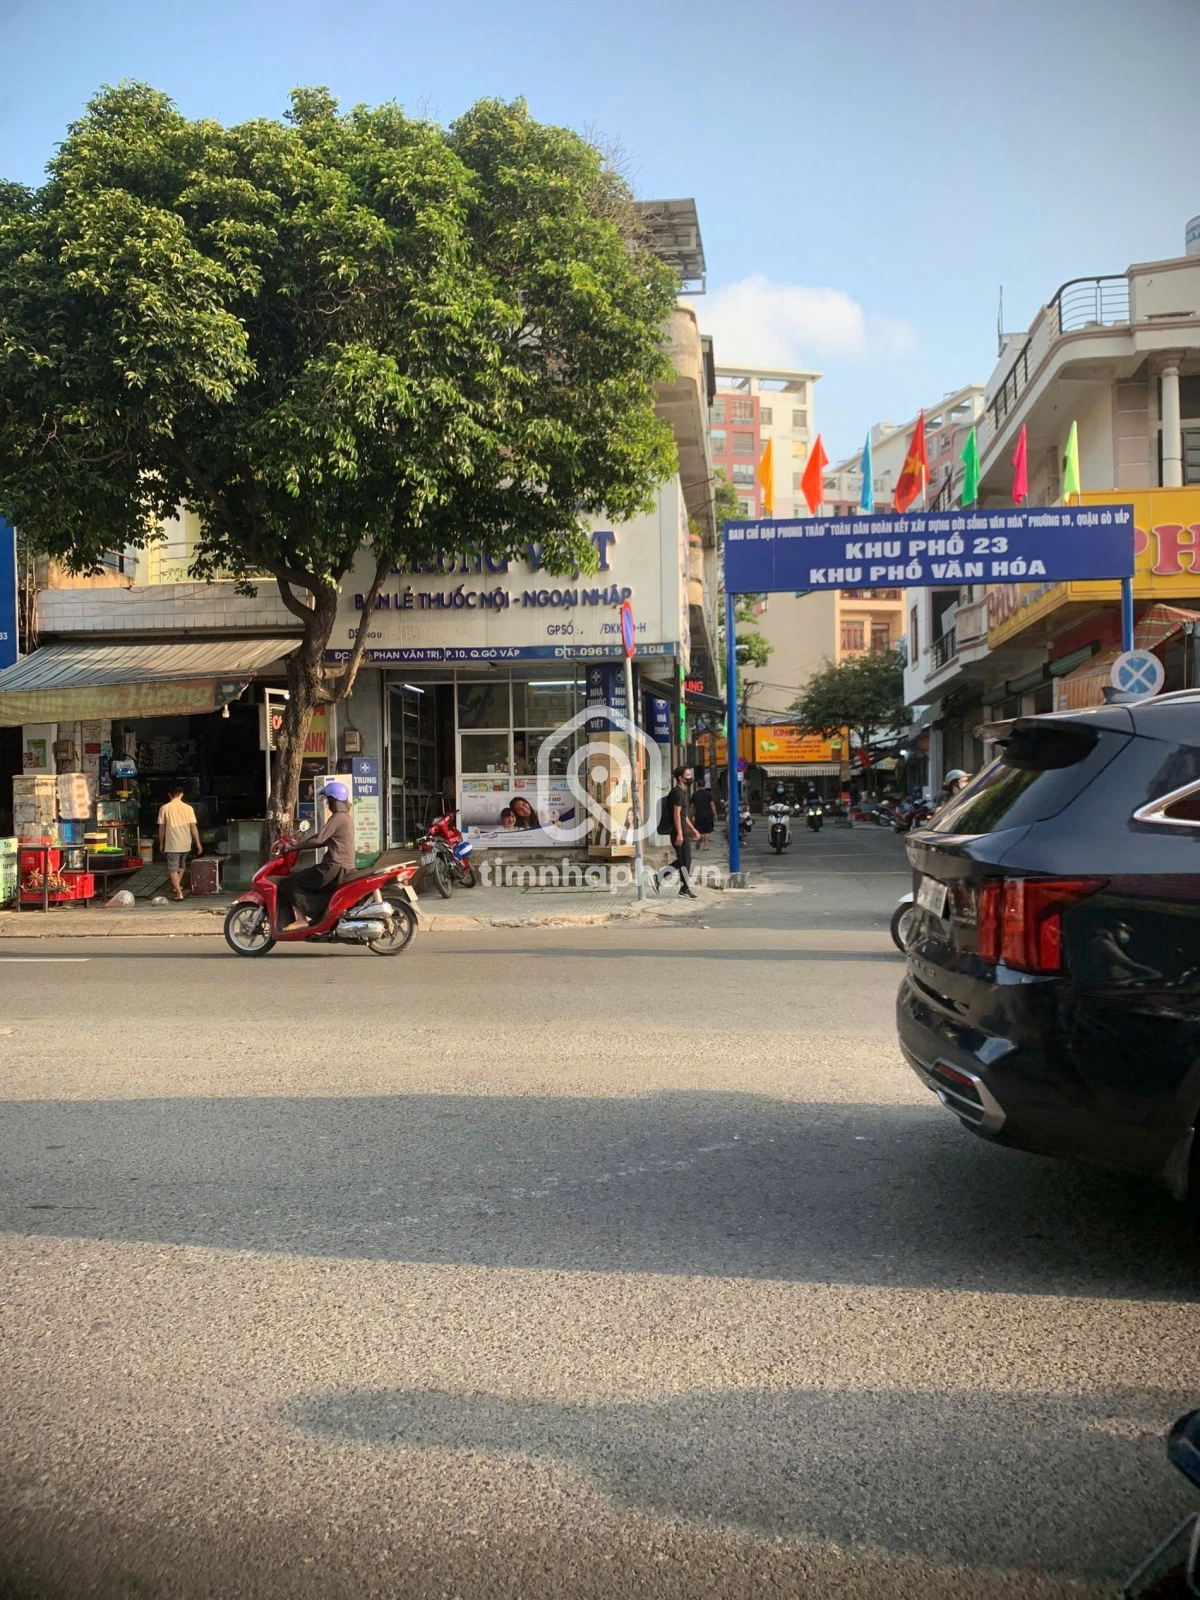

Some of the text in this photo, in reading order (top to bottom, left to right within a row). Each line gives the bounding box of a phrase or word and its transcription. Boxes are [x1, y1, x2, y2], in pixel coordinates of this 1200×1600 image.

[728, 528, 744, 540] BAN
[777, 526, 802, 538] PHONG
[910, 517, 925, 532] XÂY
[966, 512, 988, 531] SỐNG
[1076, 511, 1099, 527] QUẬN
[1101, 511, 1112, 525] GÒ
[845, 531, 1009, 560] KHU PHỐ 23
[809, 556, 1046, 584] KHU PHỐ VĂN HÓA
[354, 593, 390, 610] BN
[395, 585, 415, 610] LẺ
[418, 583, 477, 609] THUỐC
[480, 586, 510, 613] NỘI
[523, 588, 578, 610] NGOẠI
[582, 584, 632, 609] NHẬP
[374, 651, 402, 660] PHAN
[402, 648, 425, 659] VĂN
[500, 645, 520, 659] VẤP
[580, 644, 664, 657] 0961.9.108
[615, 686, 626, 696] NH
[611, 697, 627, 706] THU
[587, 708, 607, 718] TRUNG
[611, 708, 627, 718] TRU
[354, 776, 377, 784] TRUNG
[358, 785, 373, 794] VIỆT
